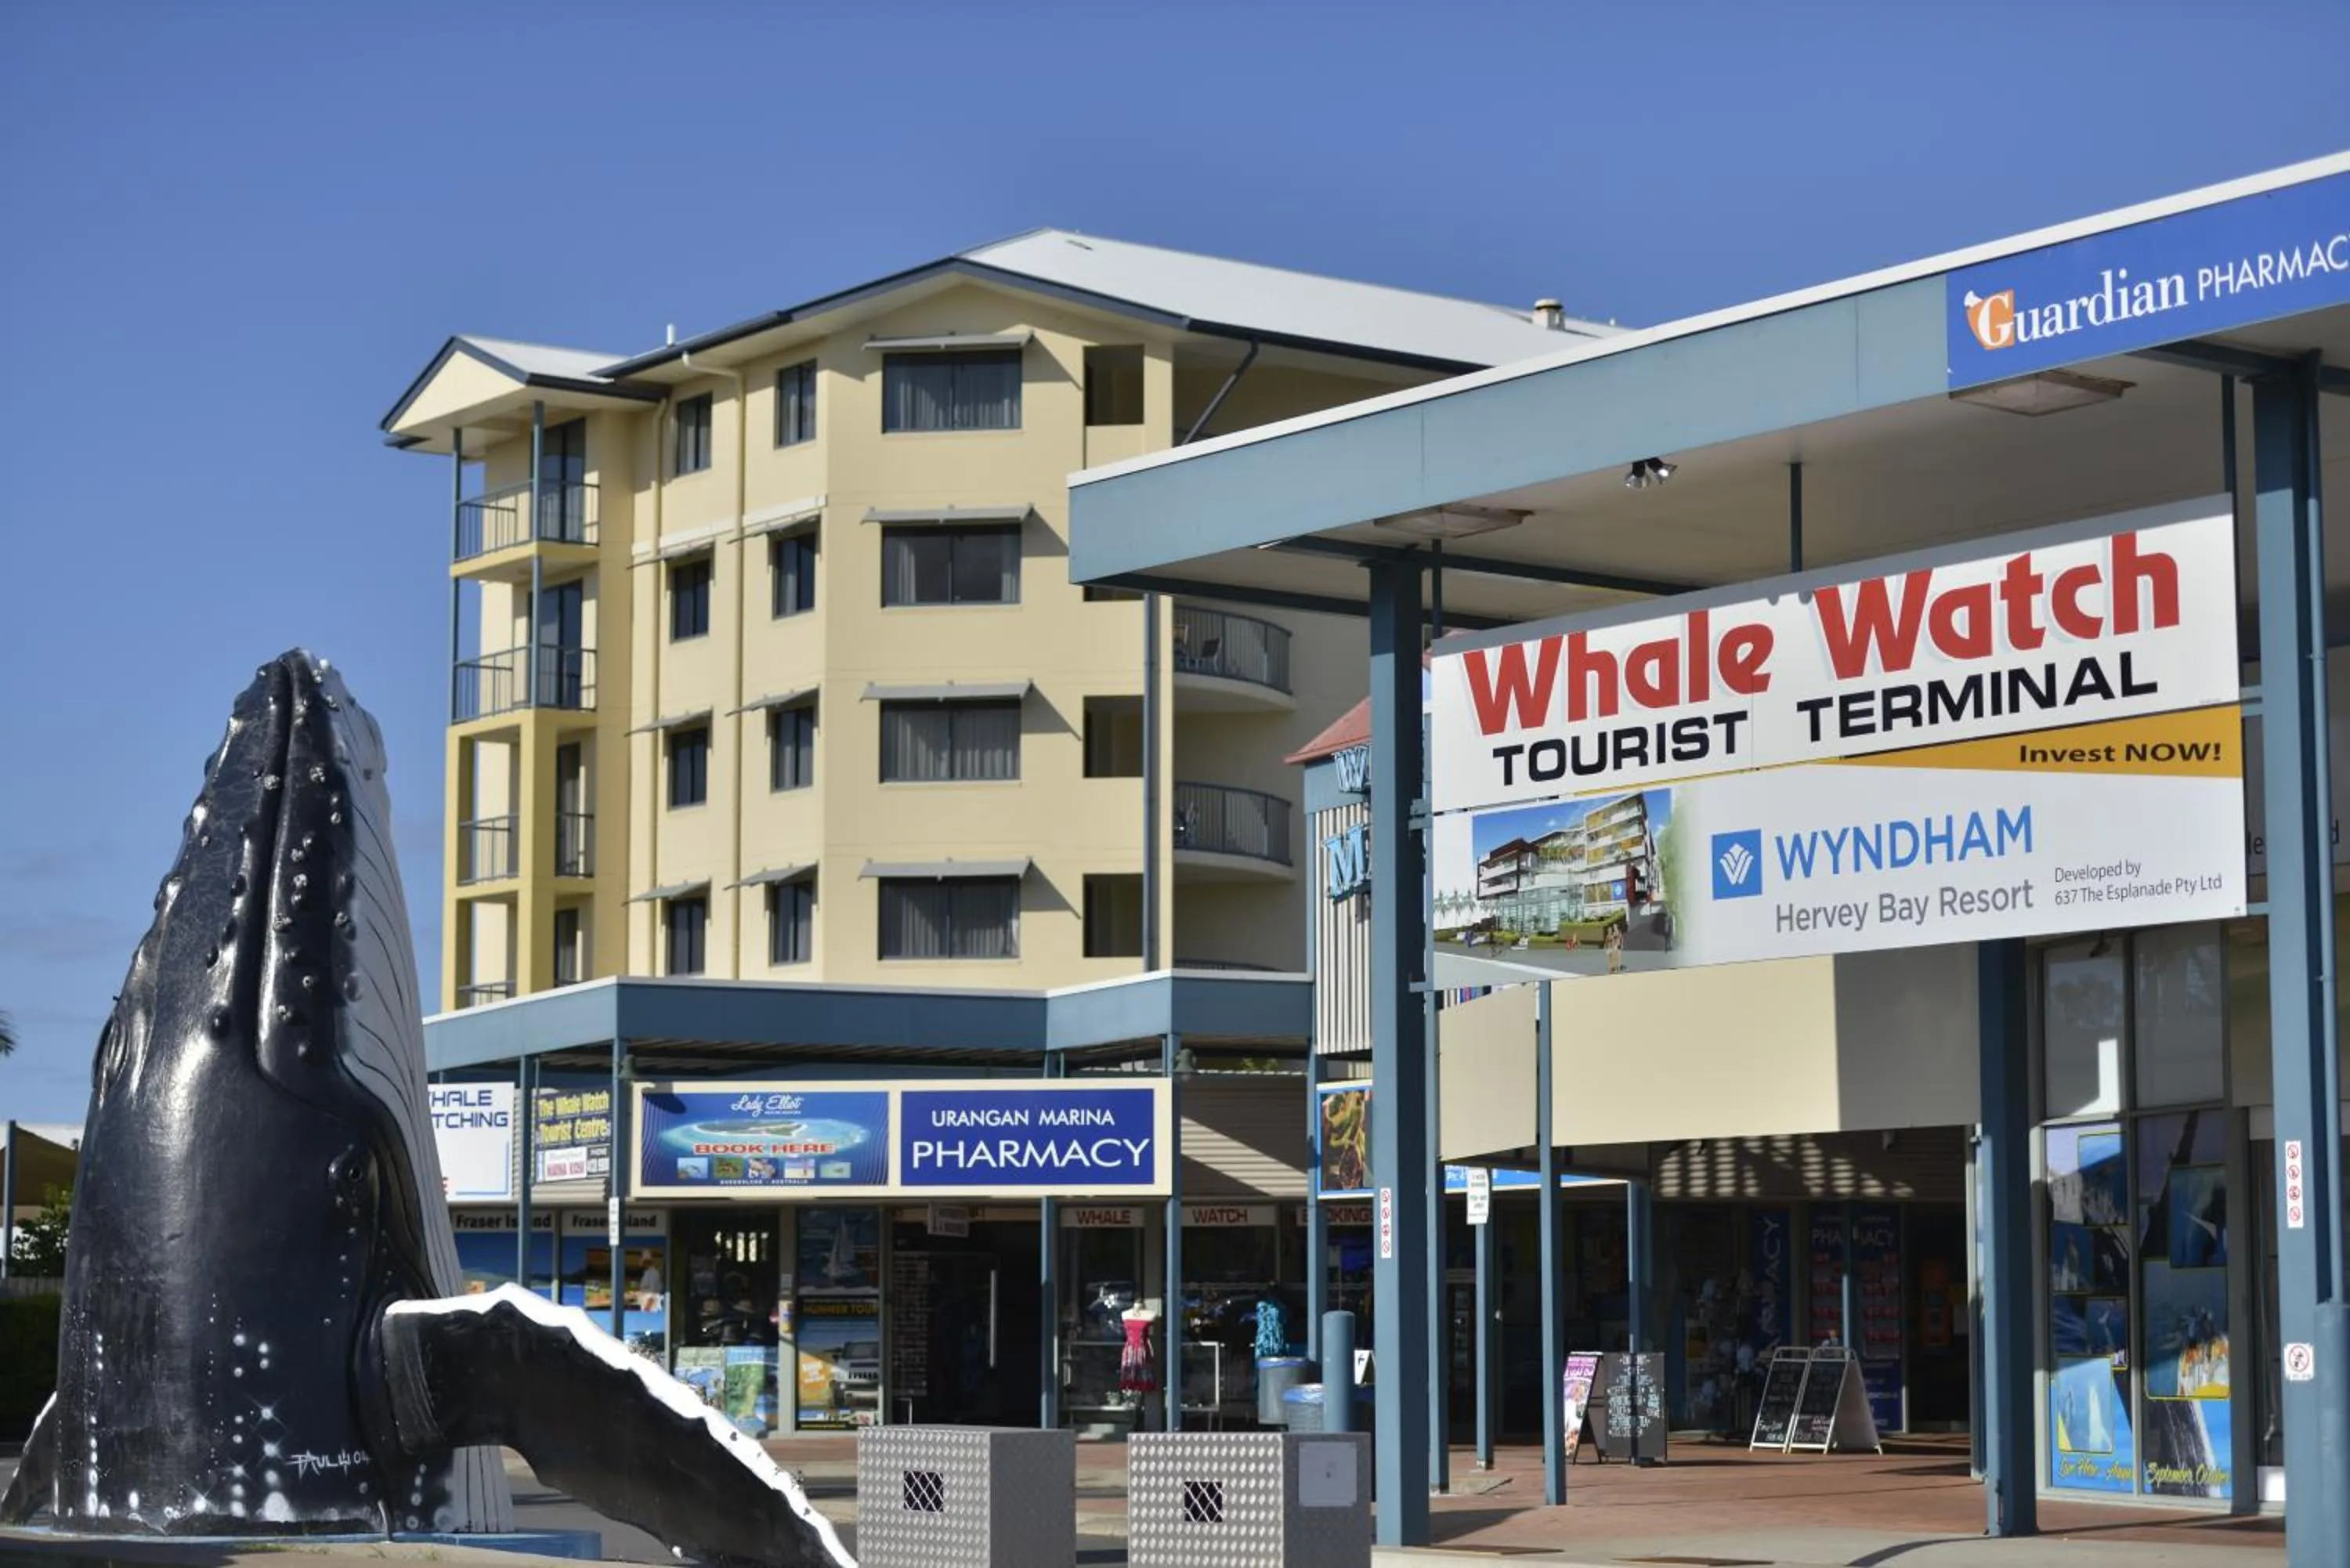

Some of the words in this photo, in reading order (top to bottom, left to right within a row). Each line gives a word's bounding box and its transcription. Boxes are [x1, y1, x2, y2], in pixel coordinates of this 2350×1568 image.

[1977, 268, 2189, 346] Guardian
[2198, 233, 2350, 301] PHARMAC
[1462, 609, 1775, 735] Whale
[1813, 530, 2180, 680] Watch
[1493, 710, 1748, 786] TOURIST
[1797, 652, 2158, 742] TERMINAL
[2019, 745, 2116, 763] Invest
[2125, 742, 2222, 761] NOW!
[1775, 805, 2033, 881] WYNDHAM
[2055, 859, 2122, 883] Developed
[2125, 859, 2142, 877] by
[2055, 890, 2077, 905] 637
[2081, 887, 2103, 903] The
[2107, 879, 2172, 902] Esplanade
[2176, 877, 2197, 895] Pty
[2201, 873, 2223, 891] Ltd
[1776, 902, 1869, 933] Hervey
[1879, 893, 1929, 925] Bay
[1940, 879, 2034, 917] Resort
[429, 1089, 493, 1107] HALE
[431, 1111, 508, 1129] TCHING
[931, 1110, 1029, 1127] URANGAN
[1039, 1108, 1115, 1126] MARINA
[694, 1143, 764, 1154] BOOK
[772, 1143, 835, 1154] HERE
[913, 1138, 1150, 1169] PHARMACY
[456, 1214, 501, 1229] Fraser
[506, 1214, 551, 1228] Isnd
[573, 1215, 610, 1228] Frase
[627, 1215, 657, 1228] land
[1076, 1209, 1132, 1225] WHALE
[1192, 1209, 1249, 1224] WATCH
